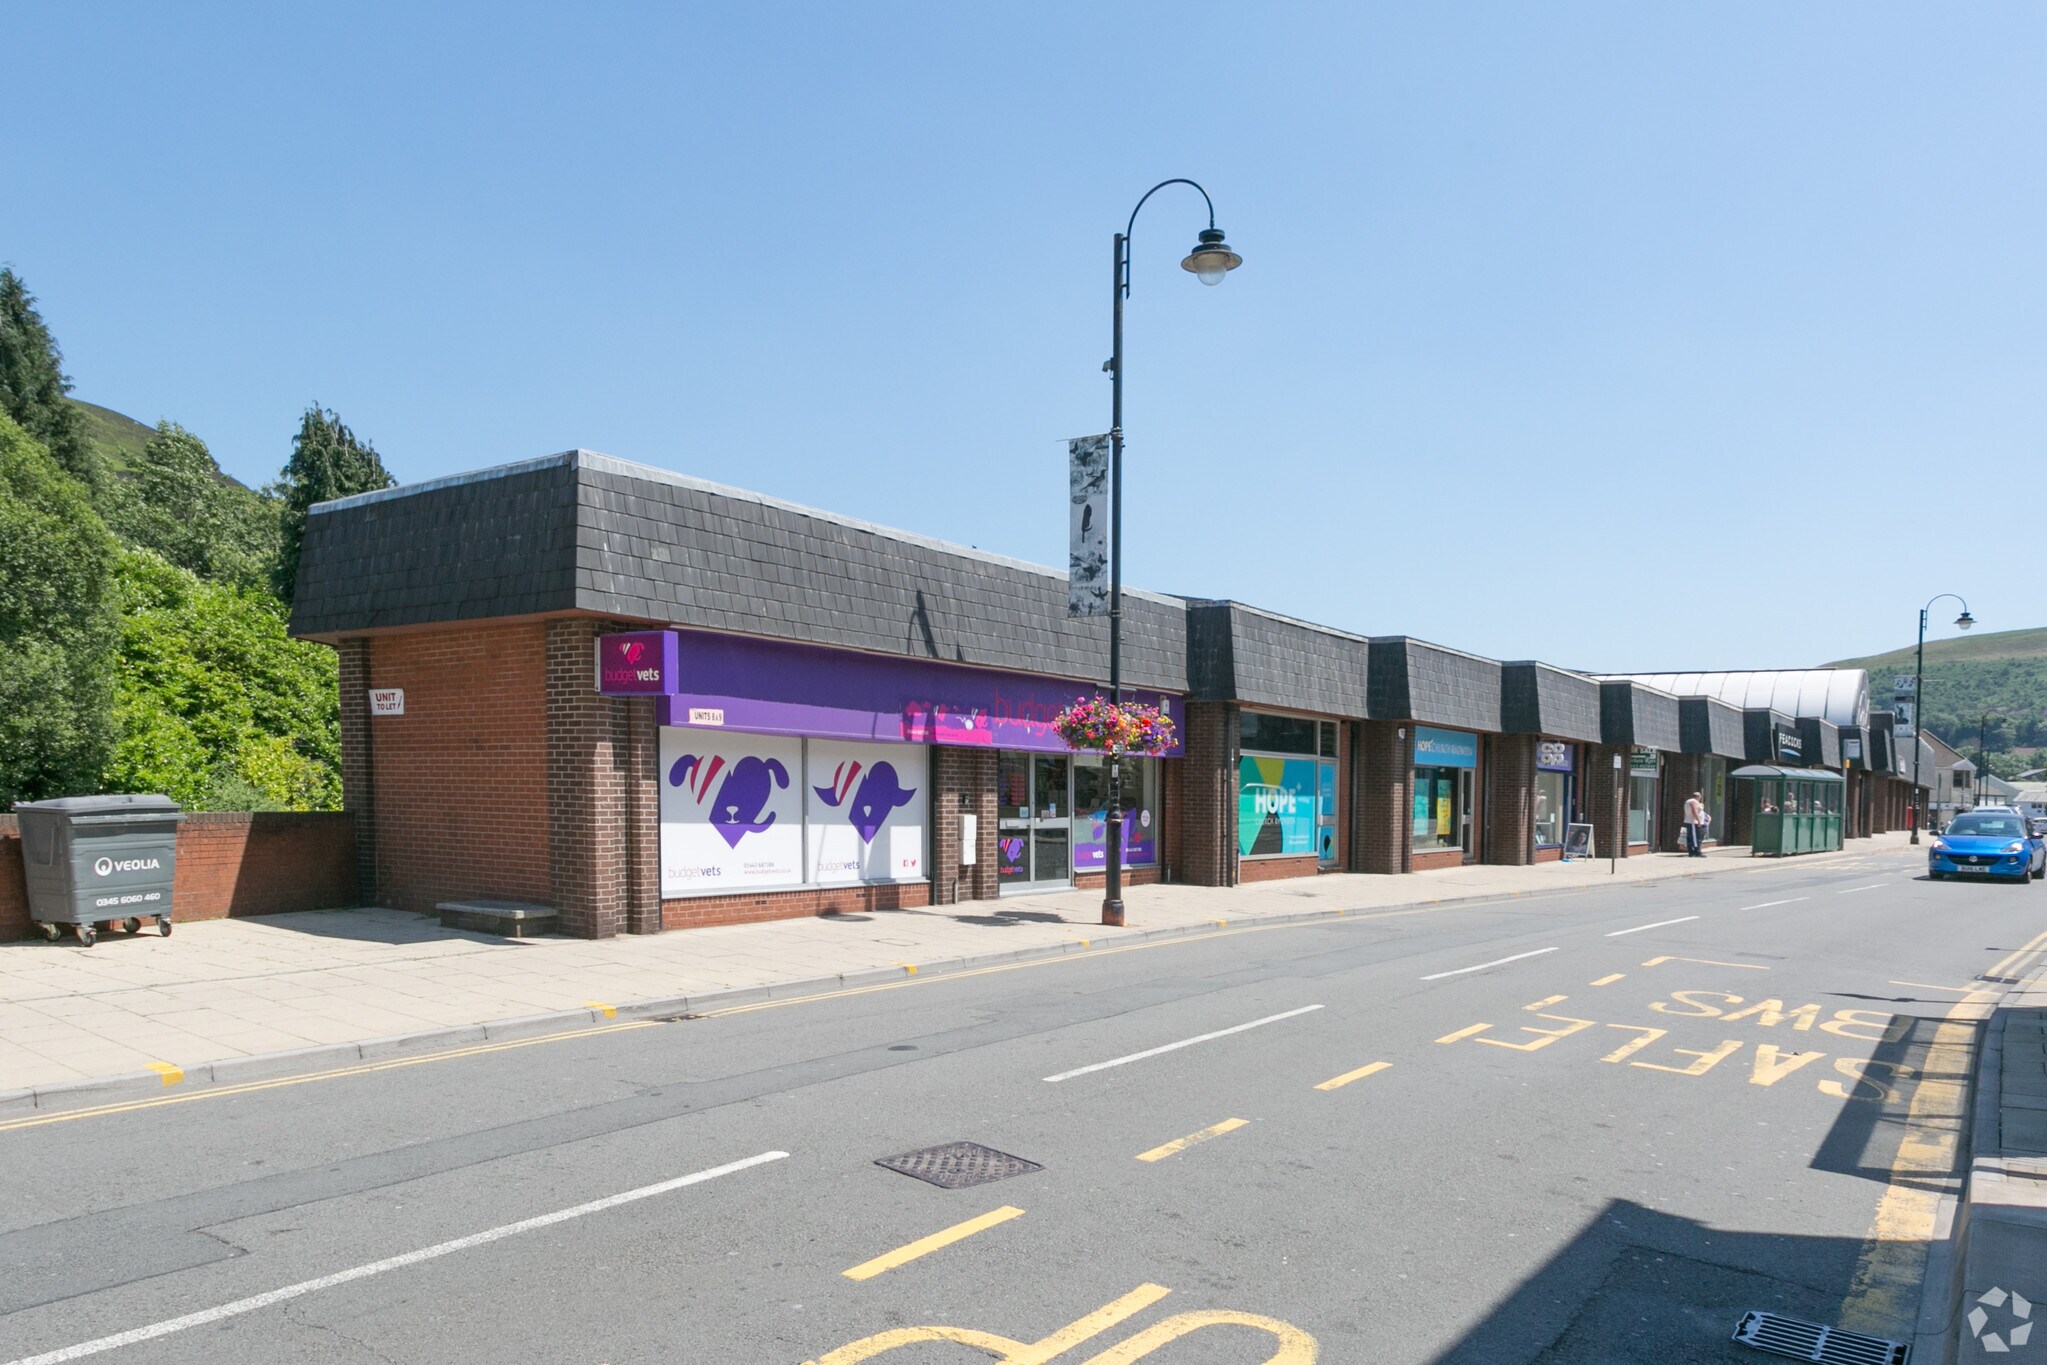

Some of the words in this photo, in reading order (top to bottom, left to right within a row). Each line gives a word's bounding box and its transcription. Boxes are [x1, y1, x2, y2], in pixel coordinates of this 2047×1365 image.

[605, 668, 660, 684] budgetvets
[375, 693, 396, 702] UNIT
[377, 703, 385, 711] TO
[694, 712, 711, 721] UNITS
[1417, 739, 1432, 752] HOPE
[1779, 732, 1802, 750] PEACOCKS
[1254, 787, 1296, 814] HOPE
[114, 858, 160, 872] VEOLIA
[668, 865, 721, 880] budgetvets
[817, 860, 860, 874] budgetvets
[96, 897, 119, 907] 0345
[120, 894, 143, 904] 6060
[144, 892, 161, 901] 460
[1648, 990, 1916, 1043] BWS
[1474, 1013, 1915, 1104] SAFLE
